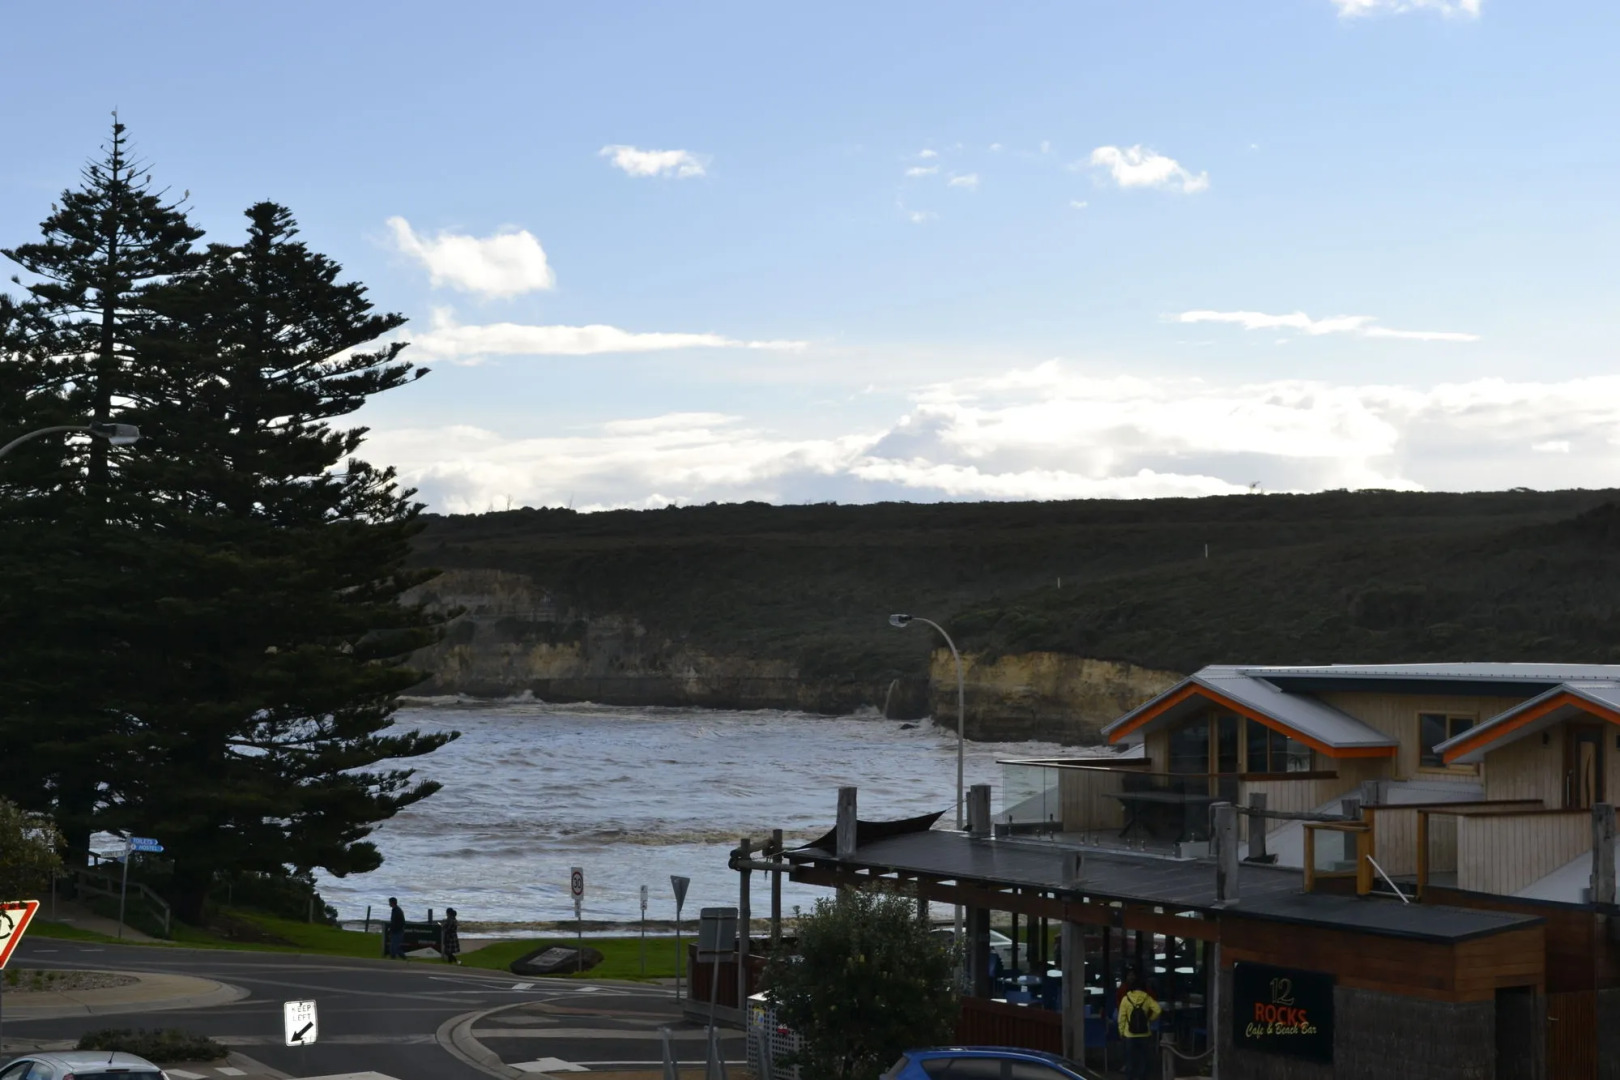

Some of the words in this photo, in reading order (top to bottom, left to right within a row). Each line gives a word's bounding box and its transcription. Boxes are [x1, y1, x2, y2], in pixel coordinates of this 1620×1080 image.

[573, 877, 582, 889] 30
[1269, 978, 1295, 1006] 12
[291, 1004, 312, 1013] KEEP
[1254, 1002, 1308, 1028] ROCKS
[292, 1013, 311, 1021] LEFT
[1245, 1022, 1264, 1039] Cafe
[1266, 1022, 1274, 1035] &
[1275, 1021, 1299, 1035] Beach
[1301, 1021, 1317, 1035] Bar
